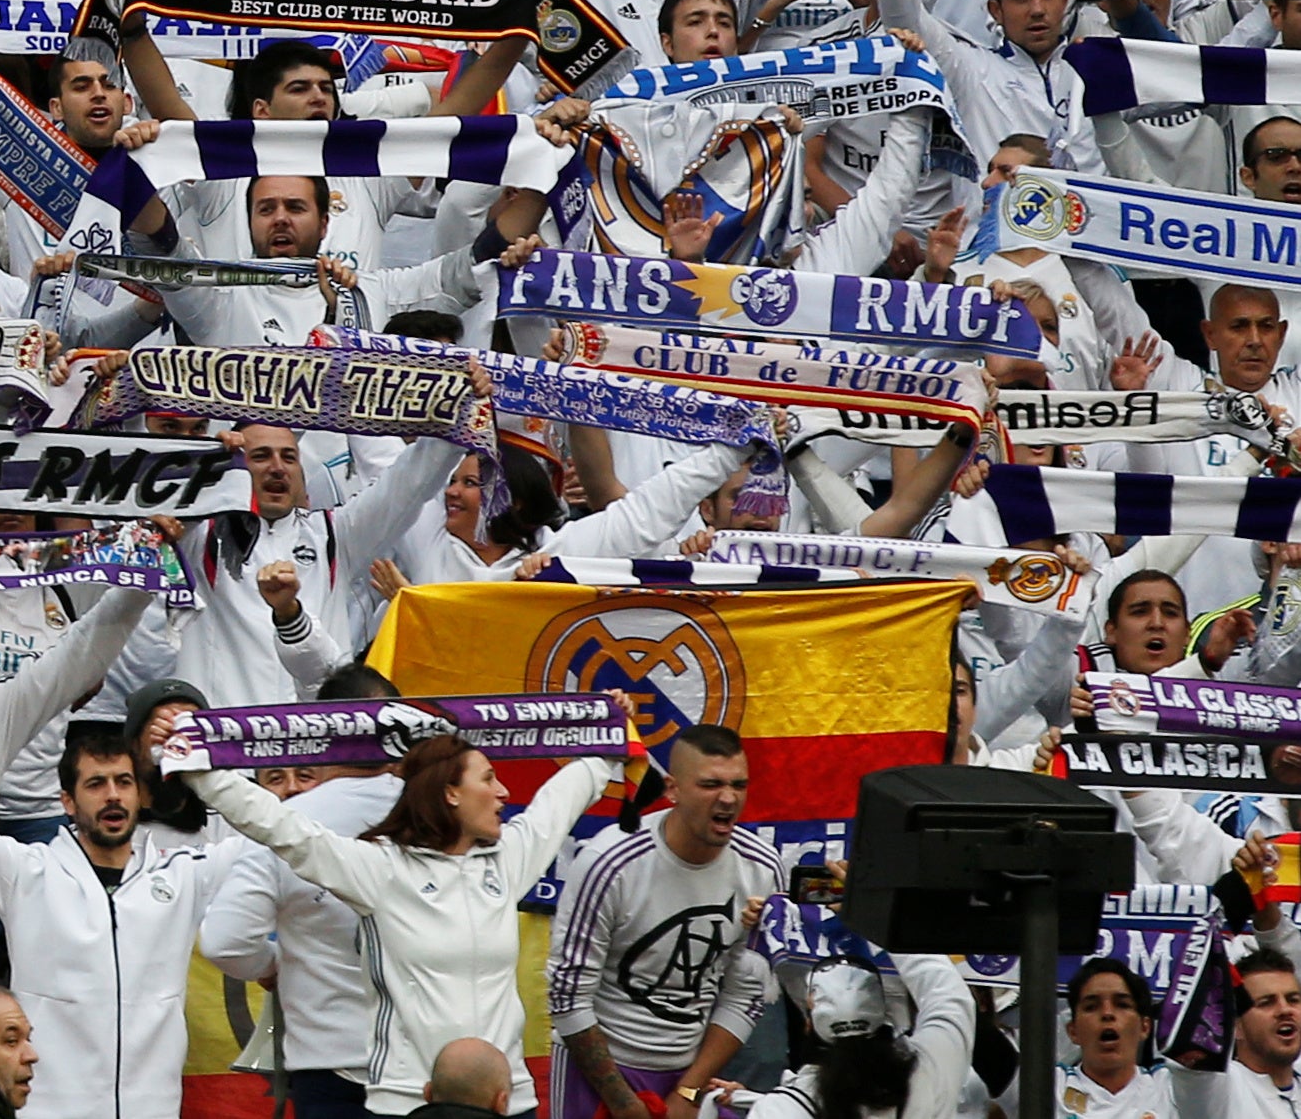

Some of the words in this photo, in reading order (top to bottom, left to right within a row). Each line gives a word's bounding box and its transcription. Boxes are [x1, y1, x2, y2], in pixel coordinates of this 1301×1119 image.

[231, 0, 273, 15] BEST
[277, 2, 322, 18] CLUB
[325, 5, 347, 20] OF
[351, 7, 386, 22] THE
[391, 10, 454, 26] WORLD
[565, 37, 609, 81] RMCF
[831, 79, 898, 98] REYES
[832, 98, 860, 114] DE
[866, 90, 944, 113] EUROPA
[1119, 204, 1235, 256] Real
[633, 348, 730, 376] CLUB
[130, 347, 330, 409] MADRID
[352, 364, 472, 424] REAL
[19, 569, 108, 589] NUNCA
[200, 716, 239, 742] LA
[1066, 743, 1105, 770] LA
